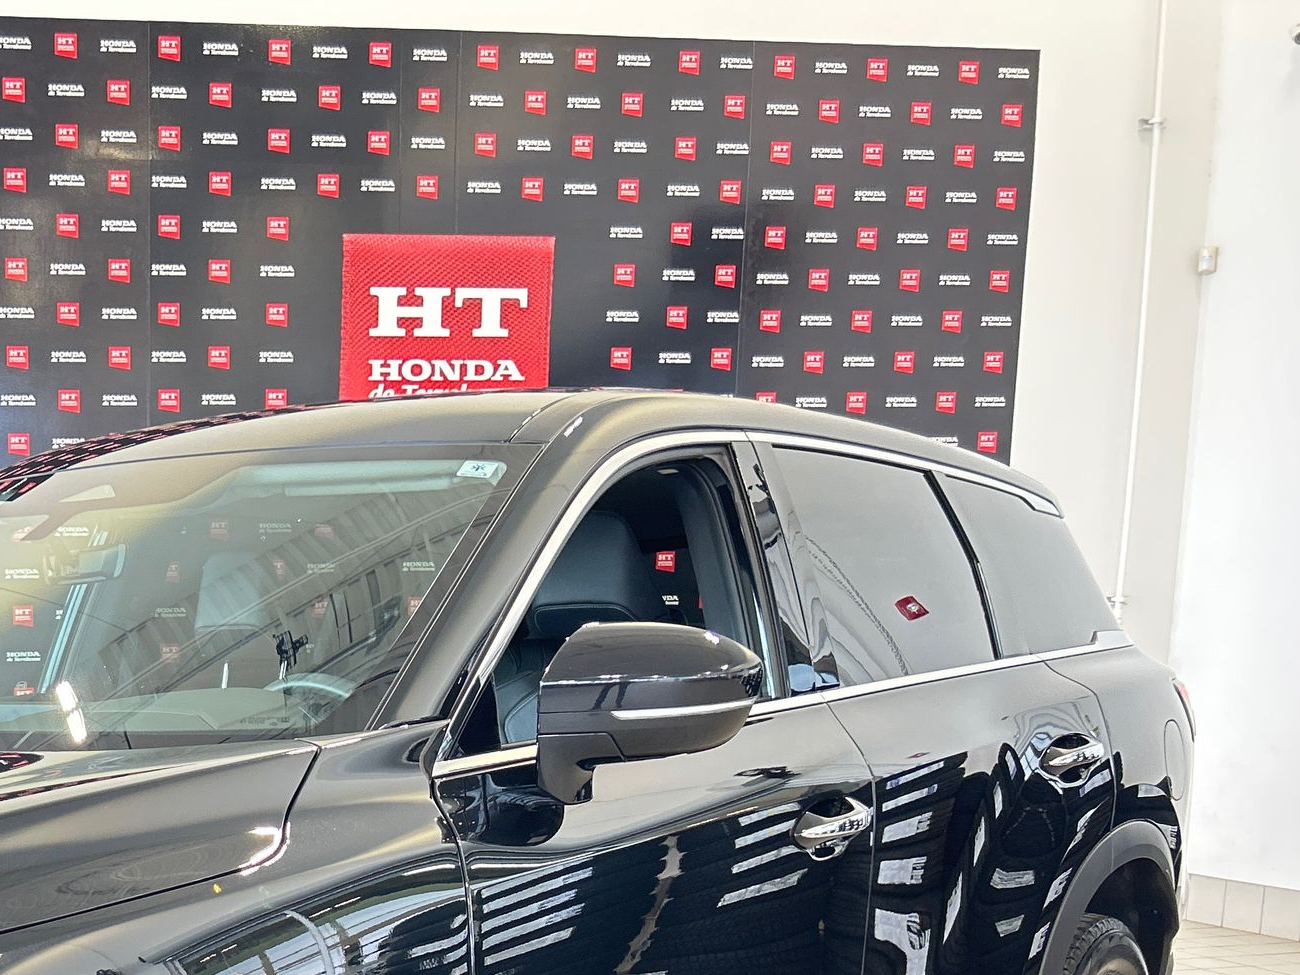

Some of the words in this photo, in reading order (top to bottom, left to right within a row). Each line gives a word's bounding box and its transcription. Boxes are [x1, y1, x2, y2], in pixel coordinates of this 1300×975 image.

[203, 42, 238, 50] HONDA
[312, 46, 347, 54] HONDA
[617, 54, 650, 62] HONDA
[720, 57, 752, 65] HONDA
[998, 67, 1029, 75] HONDA
[48, 84, 84, 92] HONDA
[261, 89, 296, 97] HONDA
[362, 92, 396, 100] HONDA
[469, 94, 503, 102] HONDA
[766, 103, 798, 111] HONDA
[202, 132, 238, 140] HONDA
[311, 135, 346, 143] HONDA
[517, 139, 551, 147] HONDA
[49, 174, 85, 182] HONDA
[467, 181, 501, 189] HONDA
[101, 219, 137, 227] HONDA
[50, 263, 85, 271] HONDA
[368, 286, 528, 338] HT
[368, 360, 525, 382] HONDA
[0, 394, 36, 402] HONDA
[102, 394, 137, 402] HONDA
